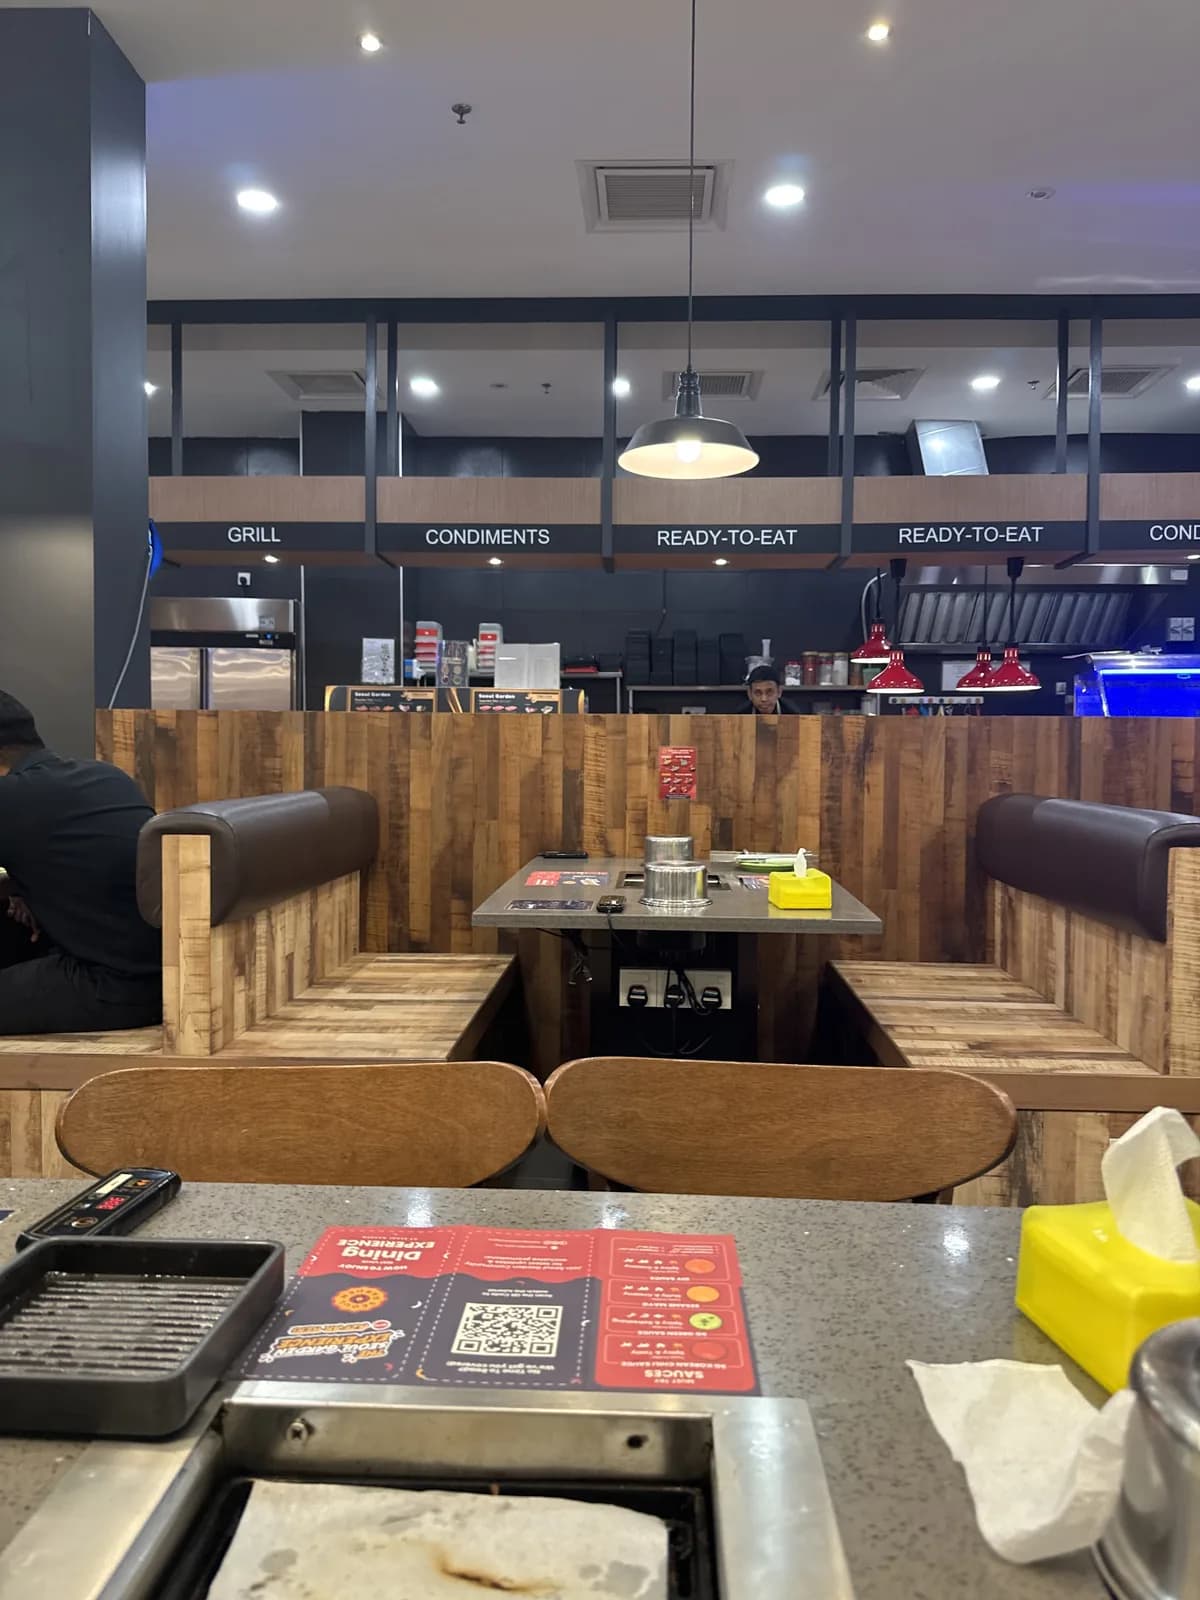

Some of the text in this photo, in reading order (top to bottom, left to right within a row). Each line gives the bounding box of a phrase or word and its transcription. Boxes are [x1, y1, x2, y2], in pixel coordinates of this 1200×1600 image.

[227, 526, 281, 543] GRILL
[425, 529, 550, 545] CONDIMENTS
[657, 529, 798, 546] READY-TO-EAT
[899, 526, 1044, 544] READY-TO-EAT
[336, 1239, 435, 1248] EXPERIENCE
[341, 1246, 422, 1261] Dining
[276, 1333, 392, 1349] EXPERIENCE
[644, 1370, 704, 1379] SAUCES
